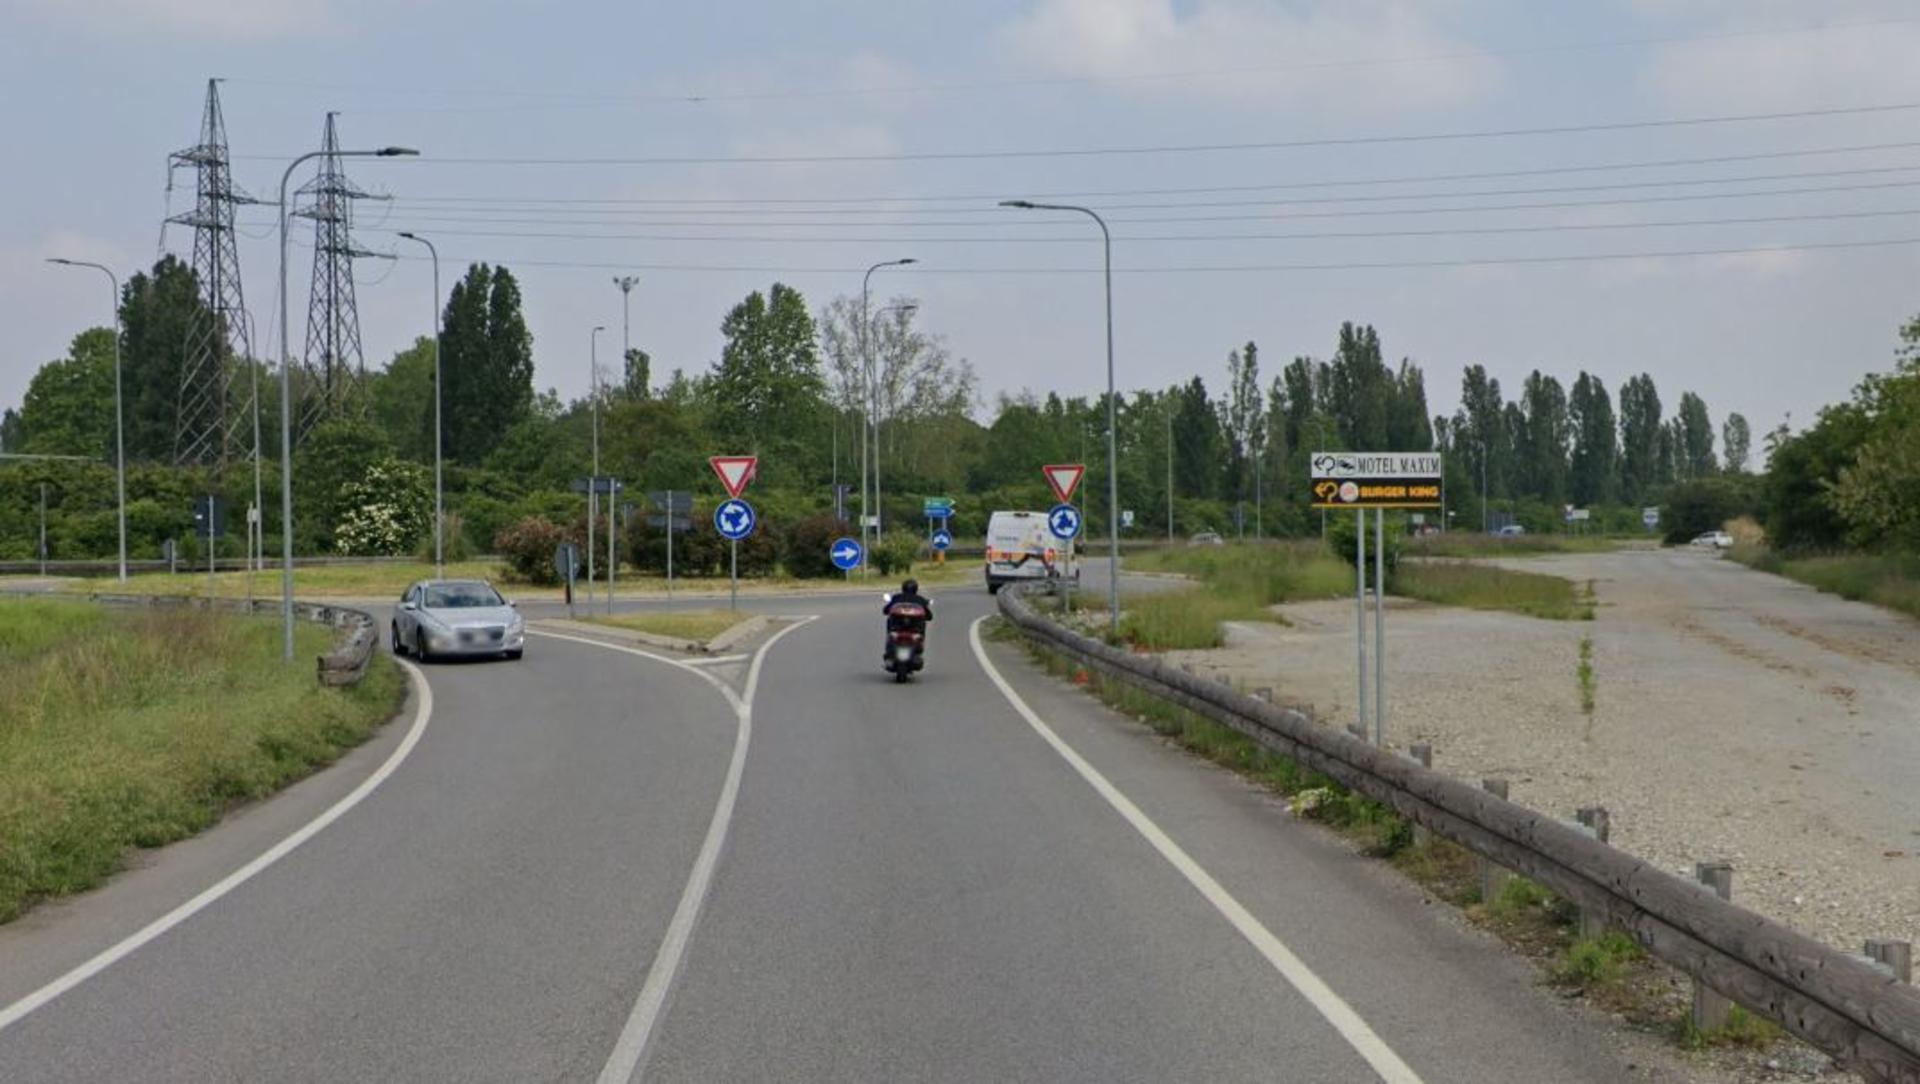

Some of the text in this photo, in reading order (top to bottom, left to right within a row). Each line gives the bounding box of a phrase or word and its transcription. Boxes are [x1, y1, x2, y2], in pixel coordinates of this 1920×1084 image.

[1358, 457, 1439, 473] MOTEL MAXIM
[1360, 486, 1439, 497] BURGER KING
